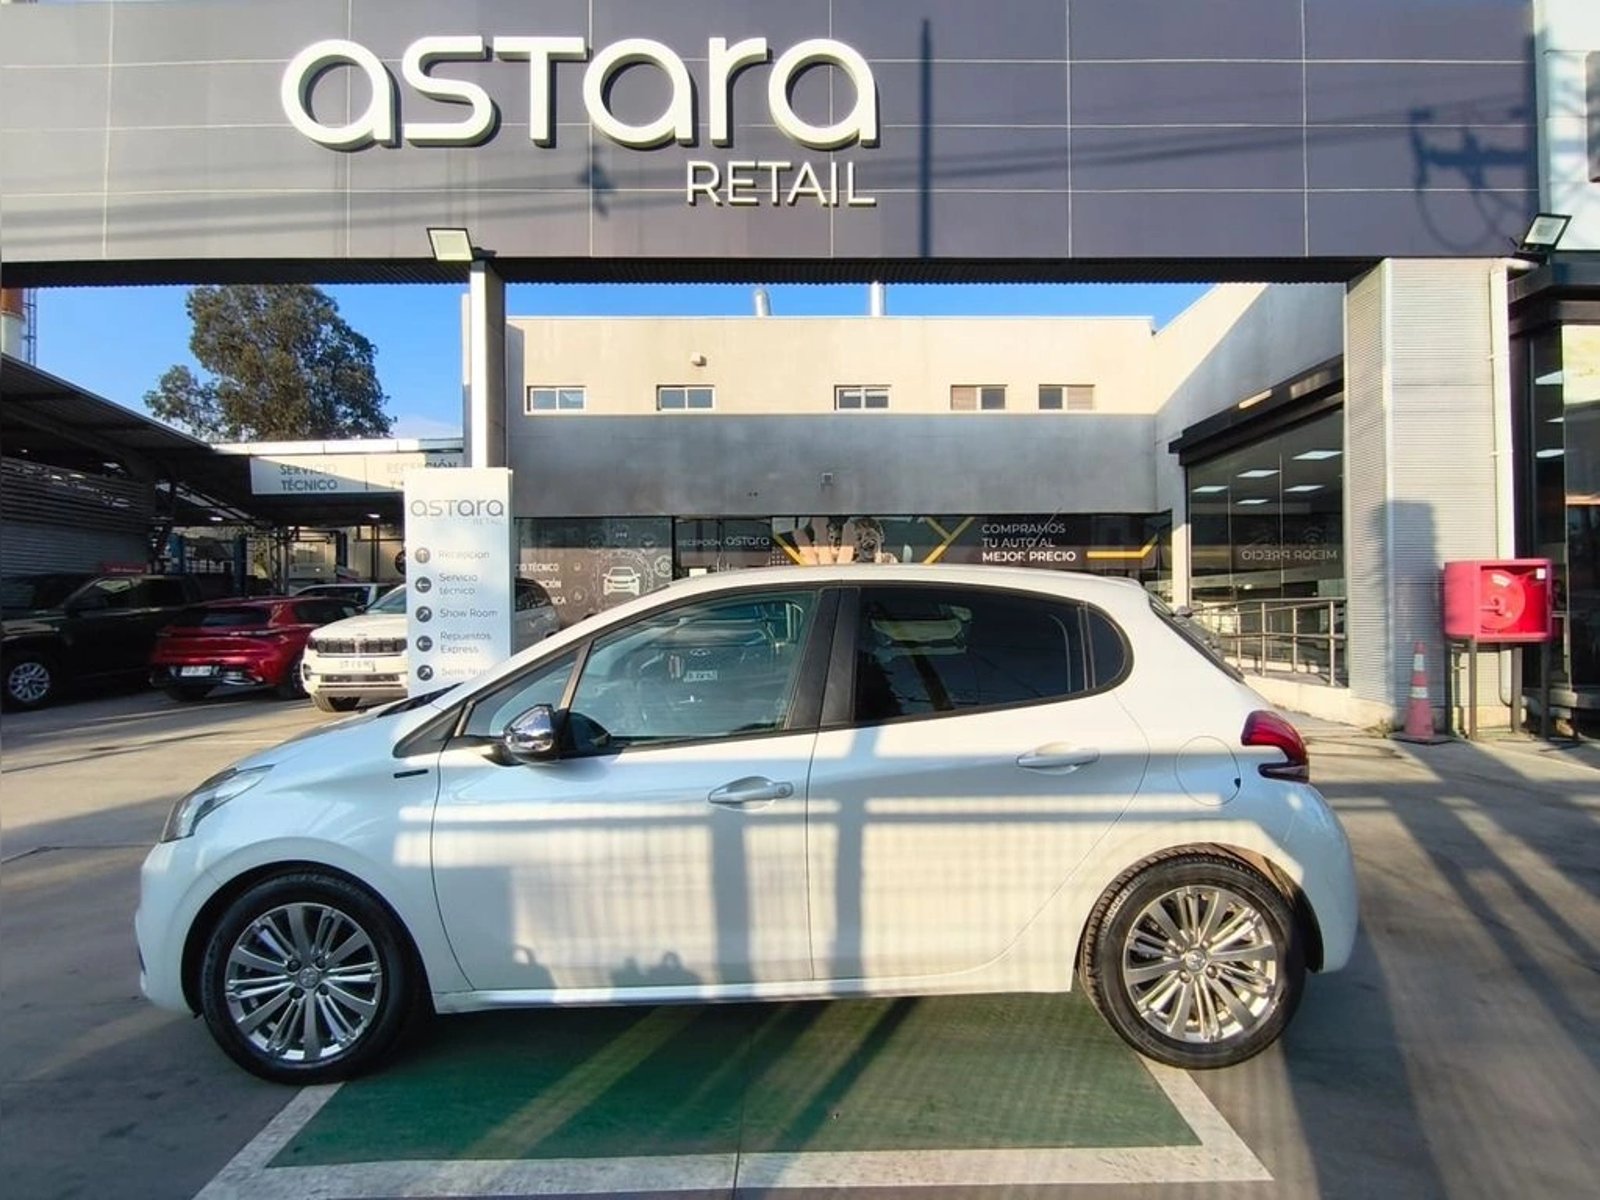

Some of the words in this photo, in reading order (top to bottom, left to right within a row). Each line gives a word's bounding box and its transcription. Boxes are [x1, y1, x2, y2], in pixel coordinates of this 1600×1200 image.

[686, 161, 877, 206] RETAIL
[281, 477, 338, 491] TÉCNICO
[981, 523, 1066, 534] COMPRAMOS
[982, 538, 998, 548] TU
[1001, 538, 1037, 548] AUTO
[1039, 538, 1056, 548] AL
[982, 551, 1025, 562] MEJOR
[1029, 551, 1076, 562] PRECIO
[438, 572, 478, 583] Servicio
[439, 607, 467, 618] Show
[470, 607, 498, 618] Room
